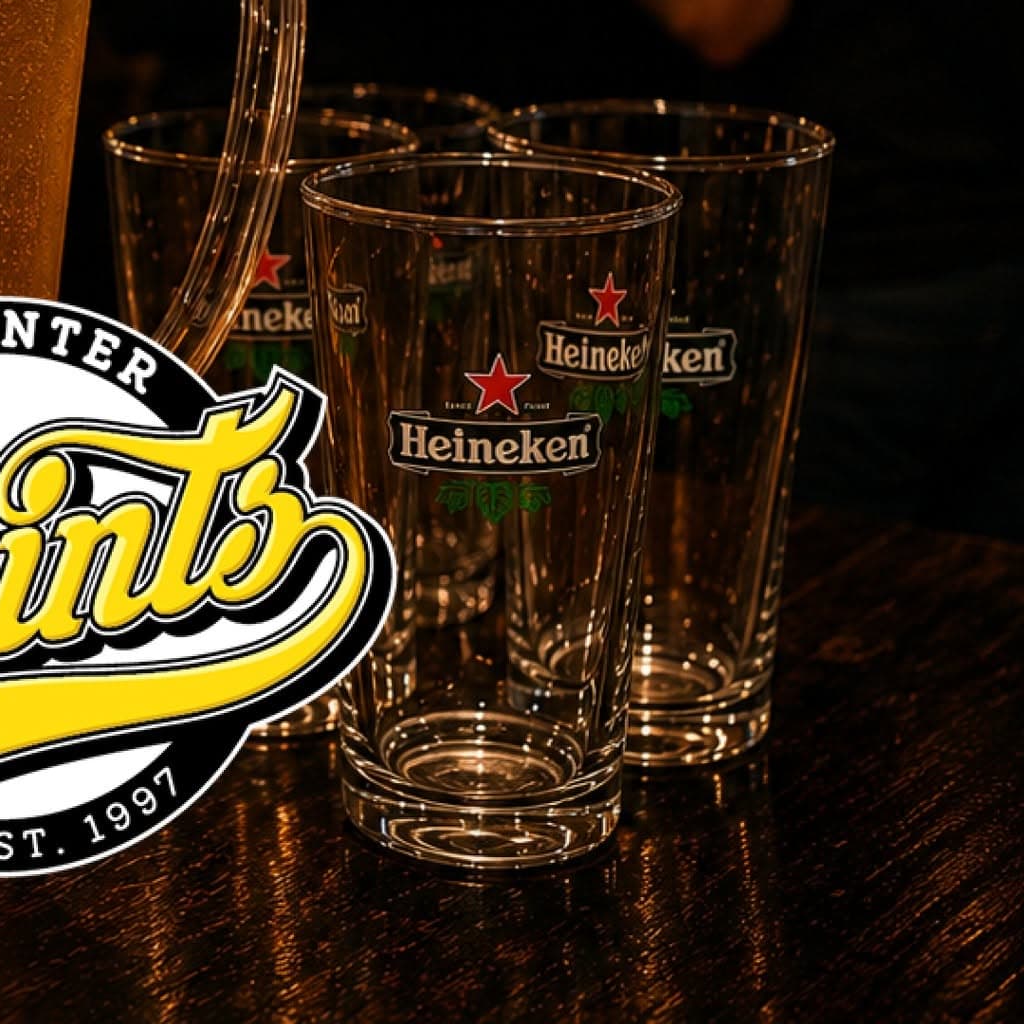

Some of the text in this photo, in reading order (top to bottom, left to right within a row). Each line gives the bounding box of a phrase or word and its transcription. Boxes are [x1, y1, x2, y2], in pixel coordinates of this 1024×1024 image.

[233, 300, 313, 332] neke
[662, 340, 726, 373] ken
[400, 422, 590, 465] Heineken
